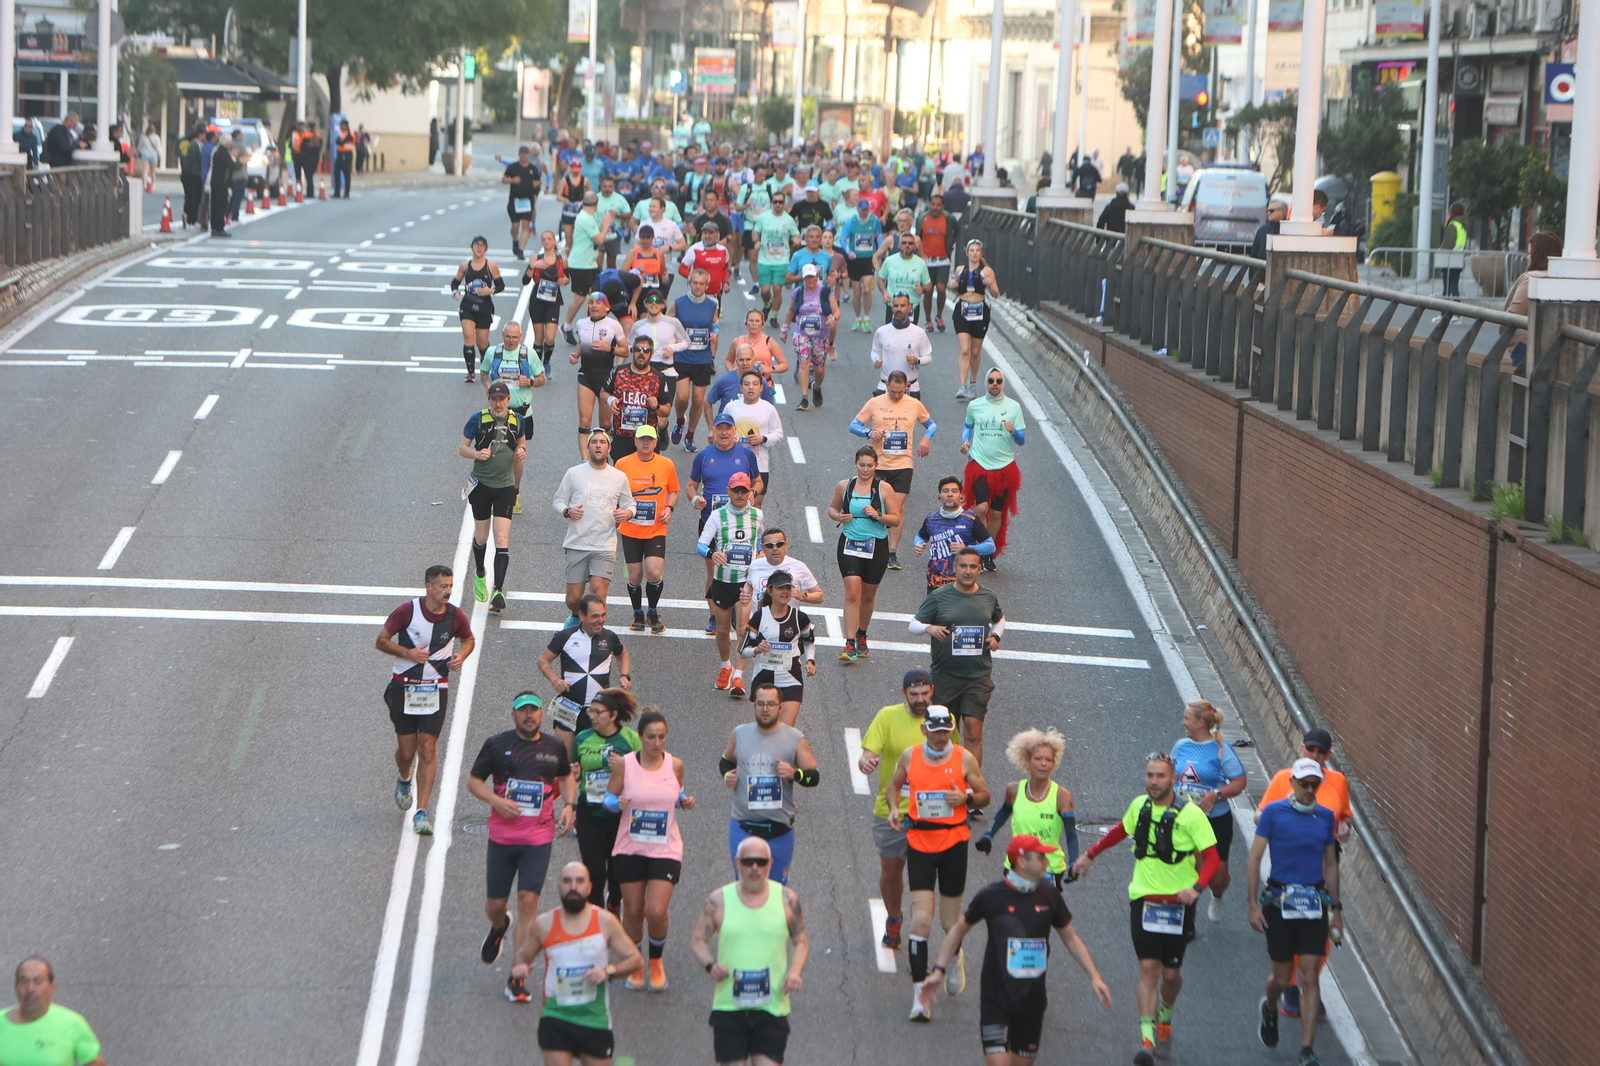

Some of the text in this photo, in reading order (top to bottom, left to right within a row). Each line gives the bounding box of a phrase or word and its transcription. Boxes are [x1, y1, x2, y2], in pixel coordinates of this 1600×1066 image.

[622, 390, 647, 406] LEÃO
[588, 482, 609, 491] Nike
[562, 700, 578, 711] ZURICH
